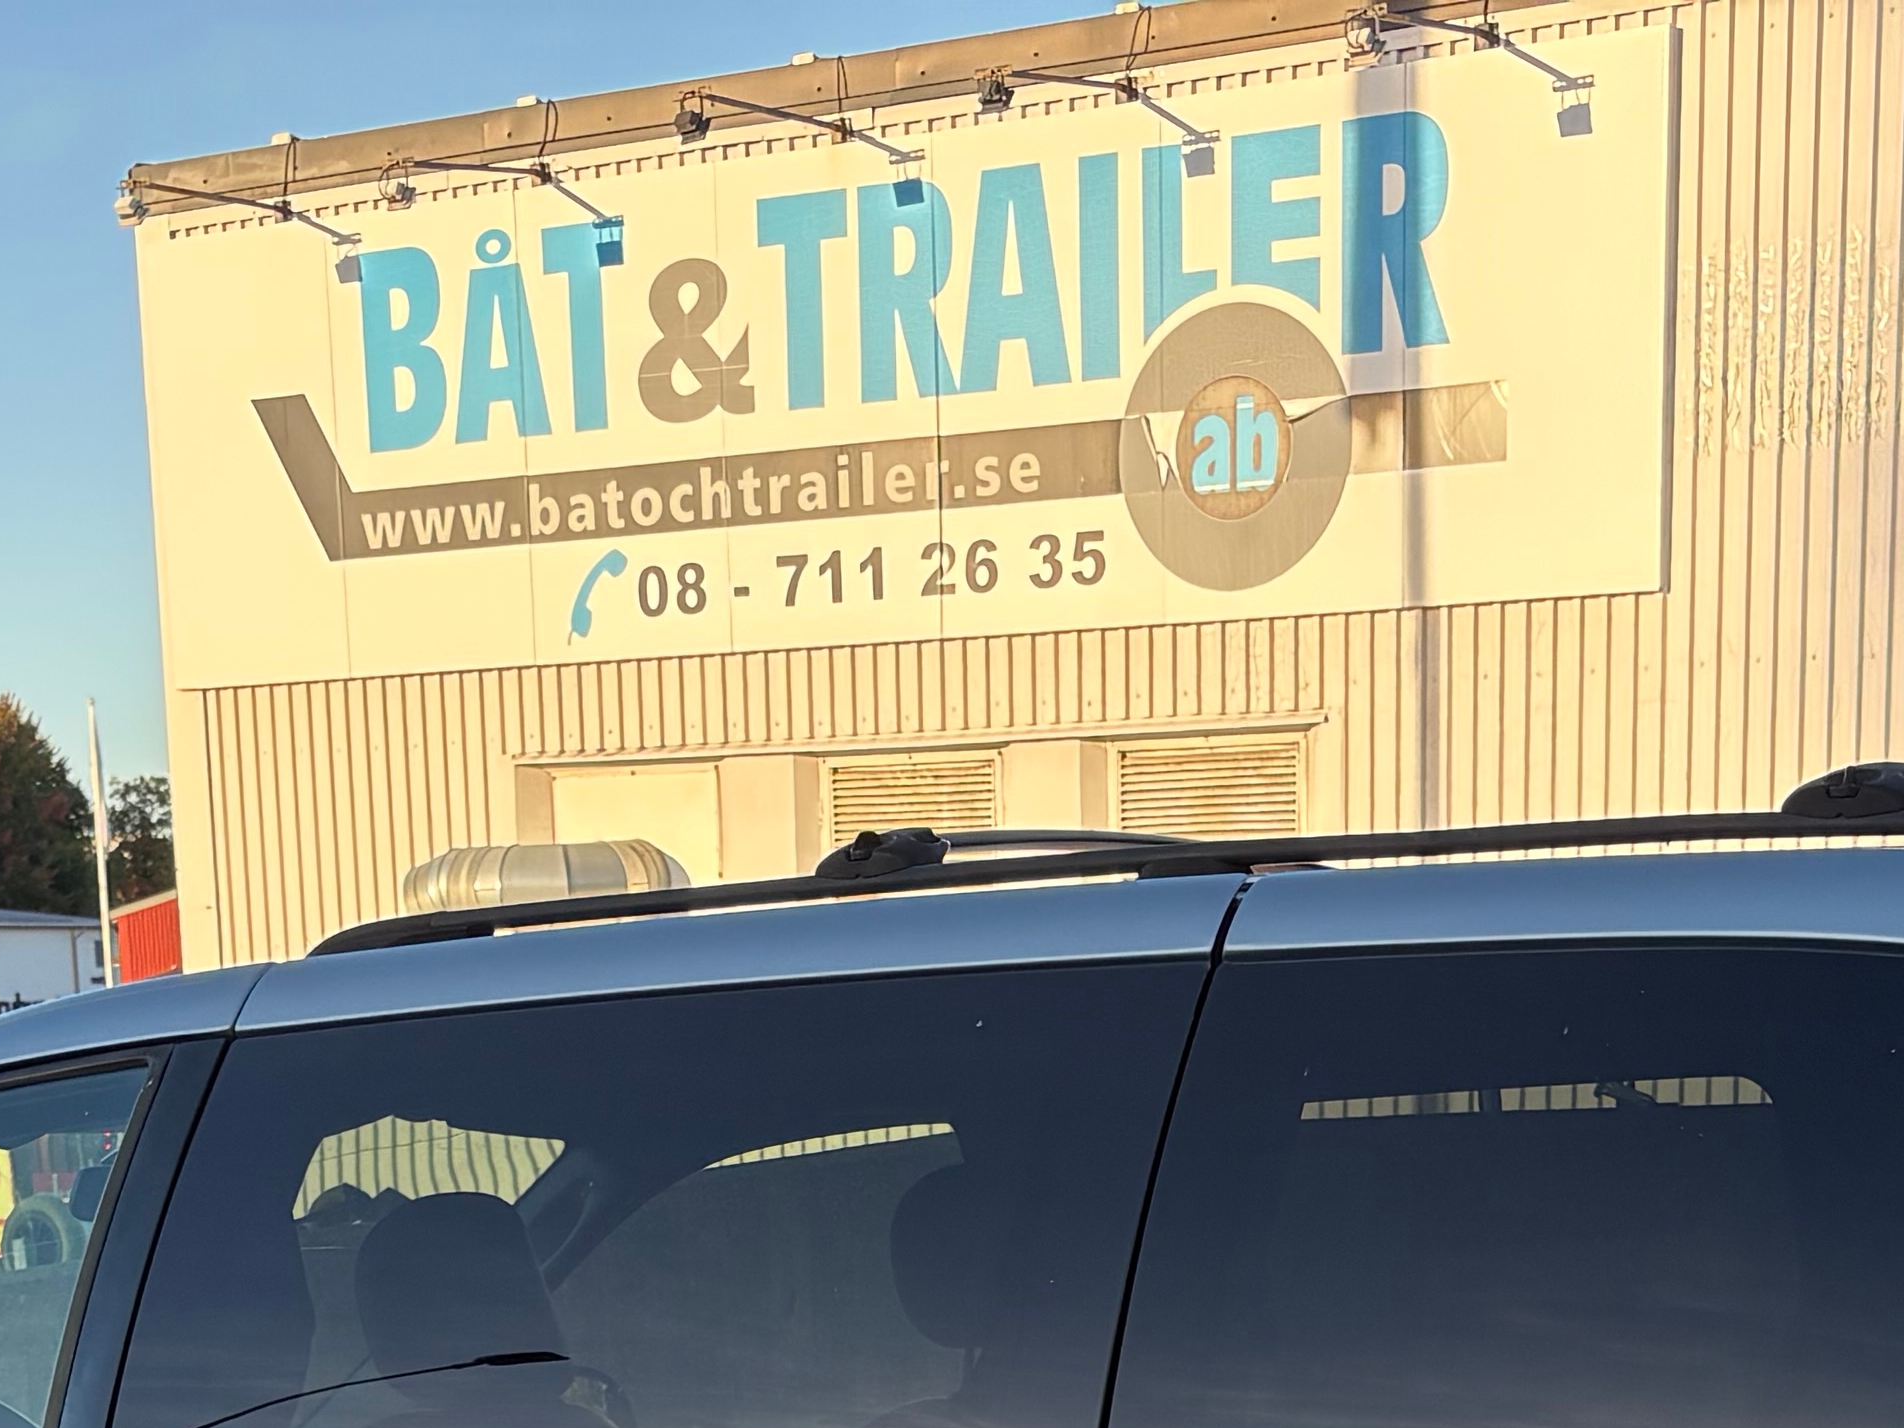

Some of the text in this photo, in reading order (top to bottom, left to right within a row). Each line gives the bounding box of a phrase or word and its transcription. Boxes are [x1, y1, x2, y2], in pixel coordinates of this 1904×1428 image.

[1192, 395, 1279, 495] ab
[361, 450, 1041, 550] www.batochtrailer.se
[637, 561, 708, 618] 08
[775, 545, 884, 607] 711
[920, 538, 999, 597] 26
[1028, 530, 1106, 589] 35
